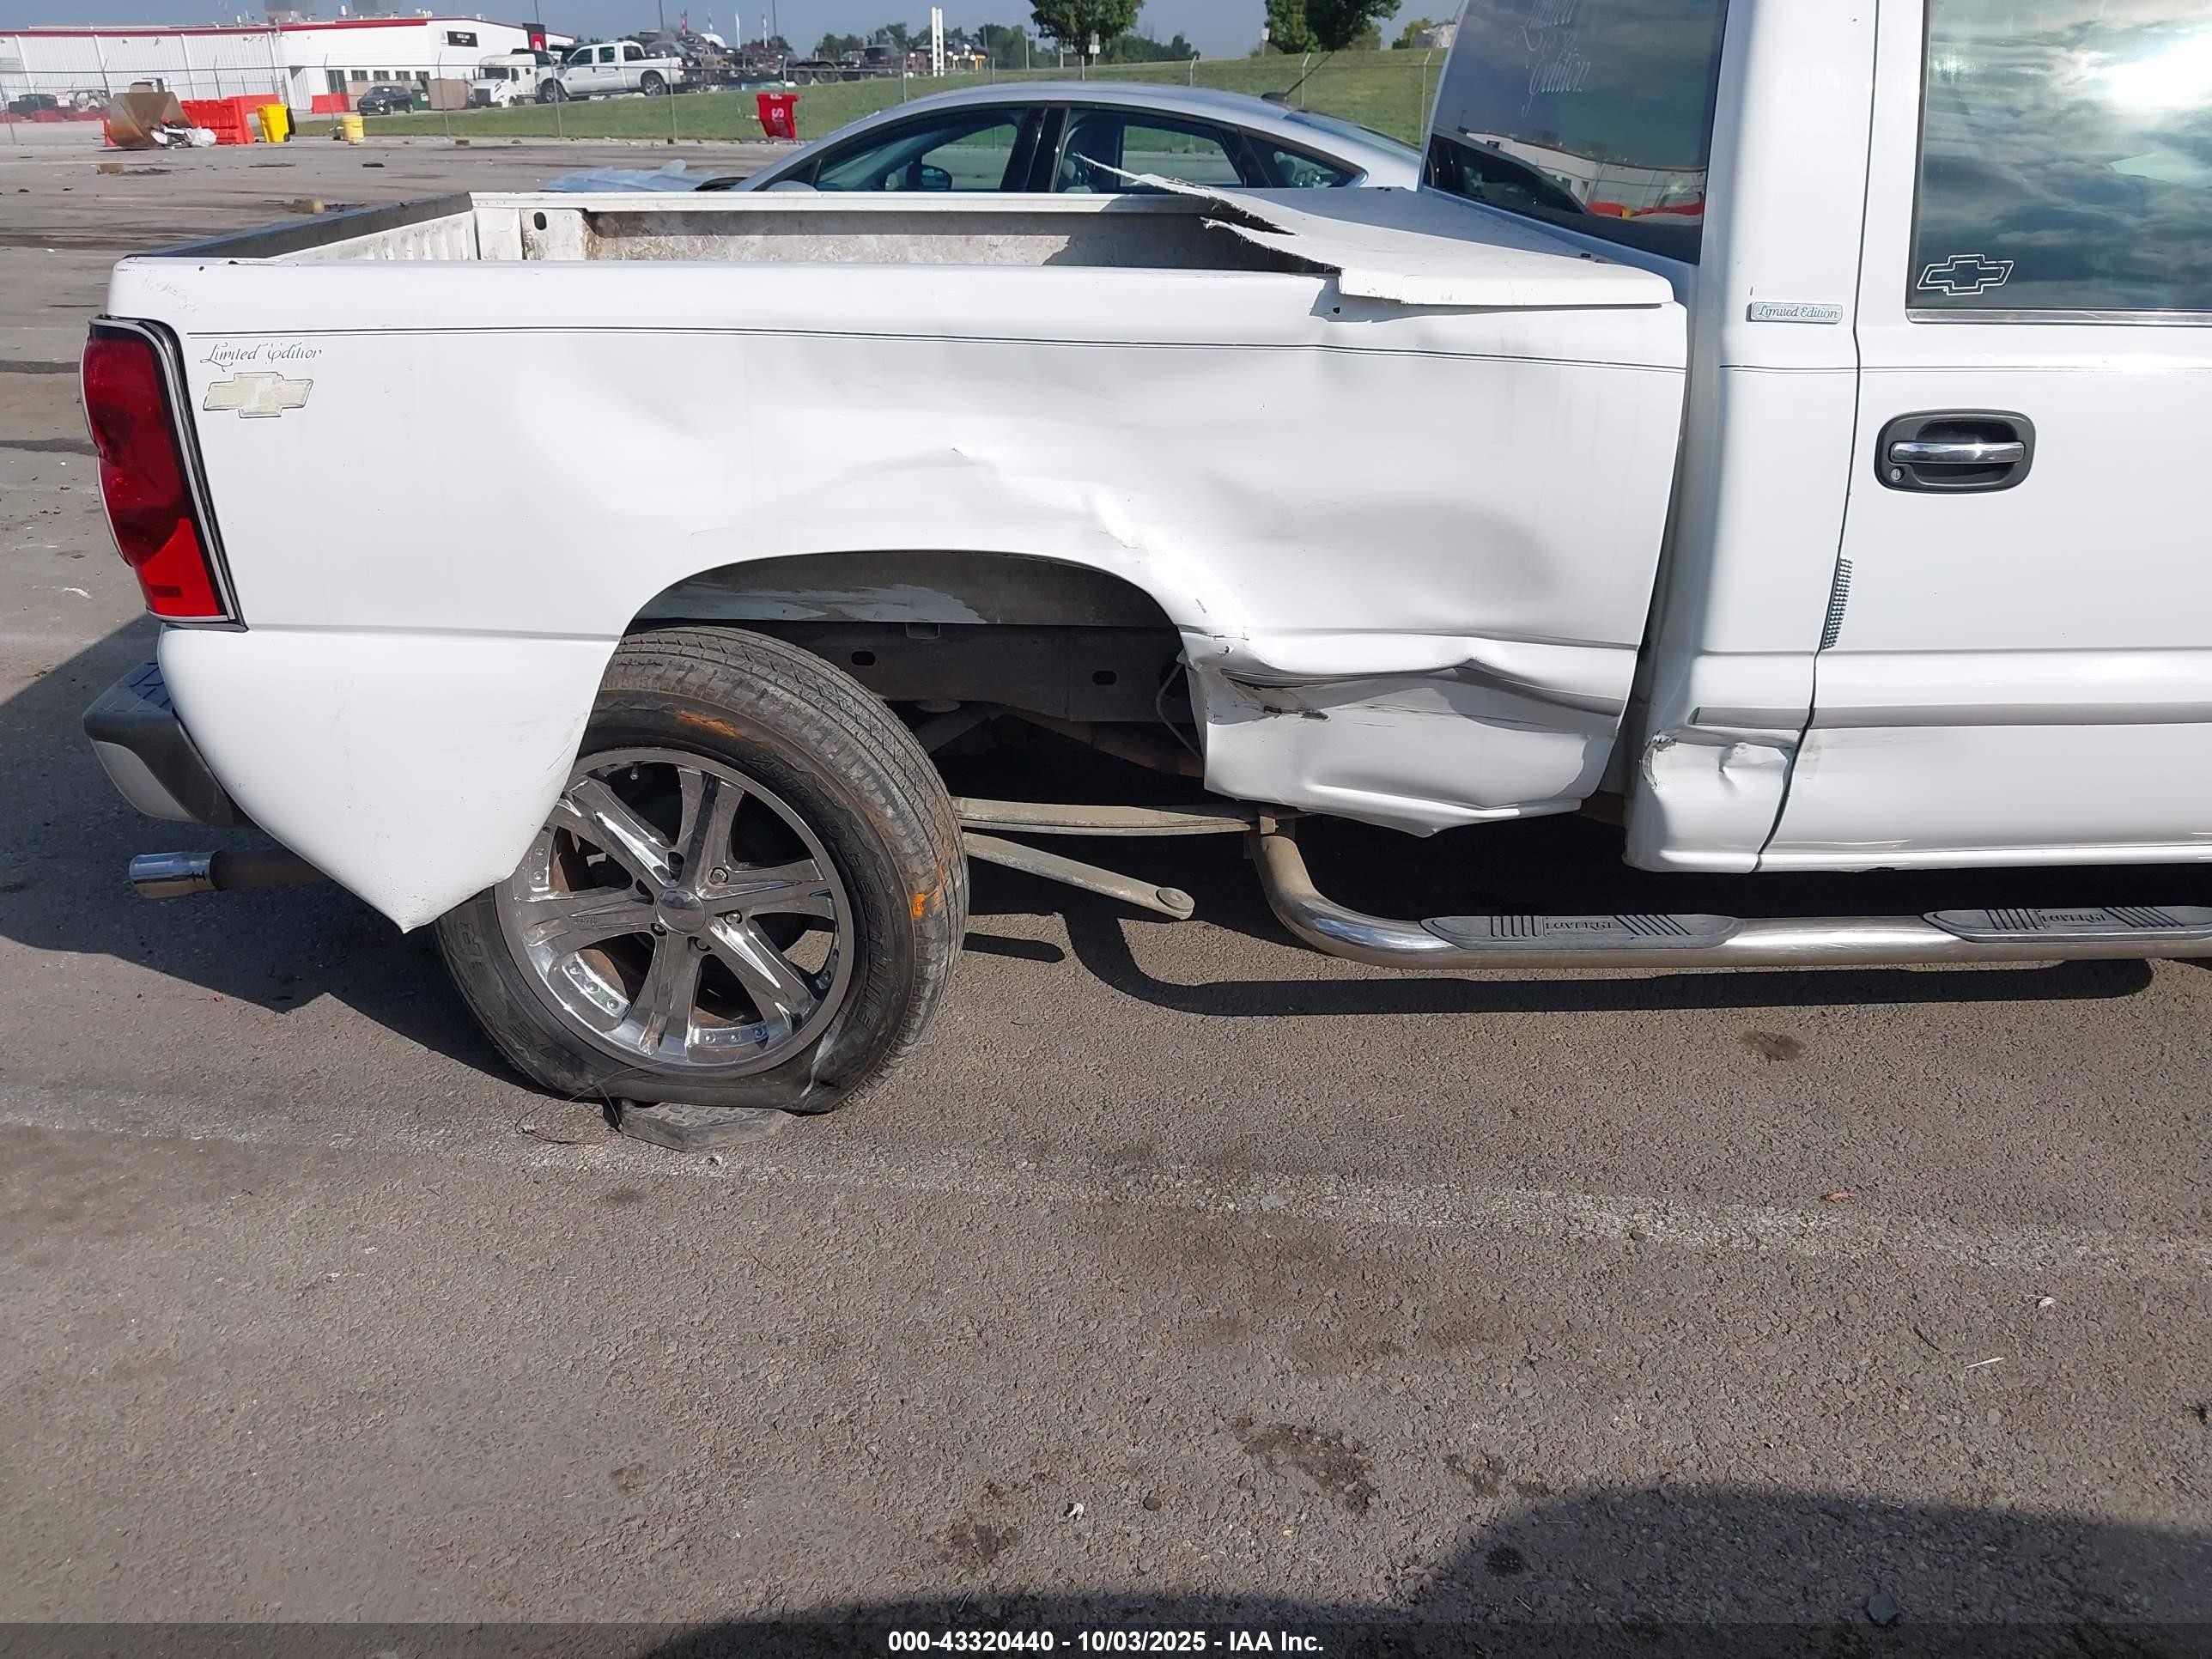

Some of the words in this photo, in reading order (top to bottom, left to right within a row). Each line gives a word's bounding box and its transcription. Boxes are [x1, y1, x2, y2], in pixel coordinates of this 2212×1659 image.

[1758, 304, 1799, 319] Limited
[1800, 306, 1838, 319] Edition
[199, 342, 269, 372] Limited
[265, 342, 323, 365] Edition
